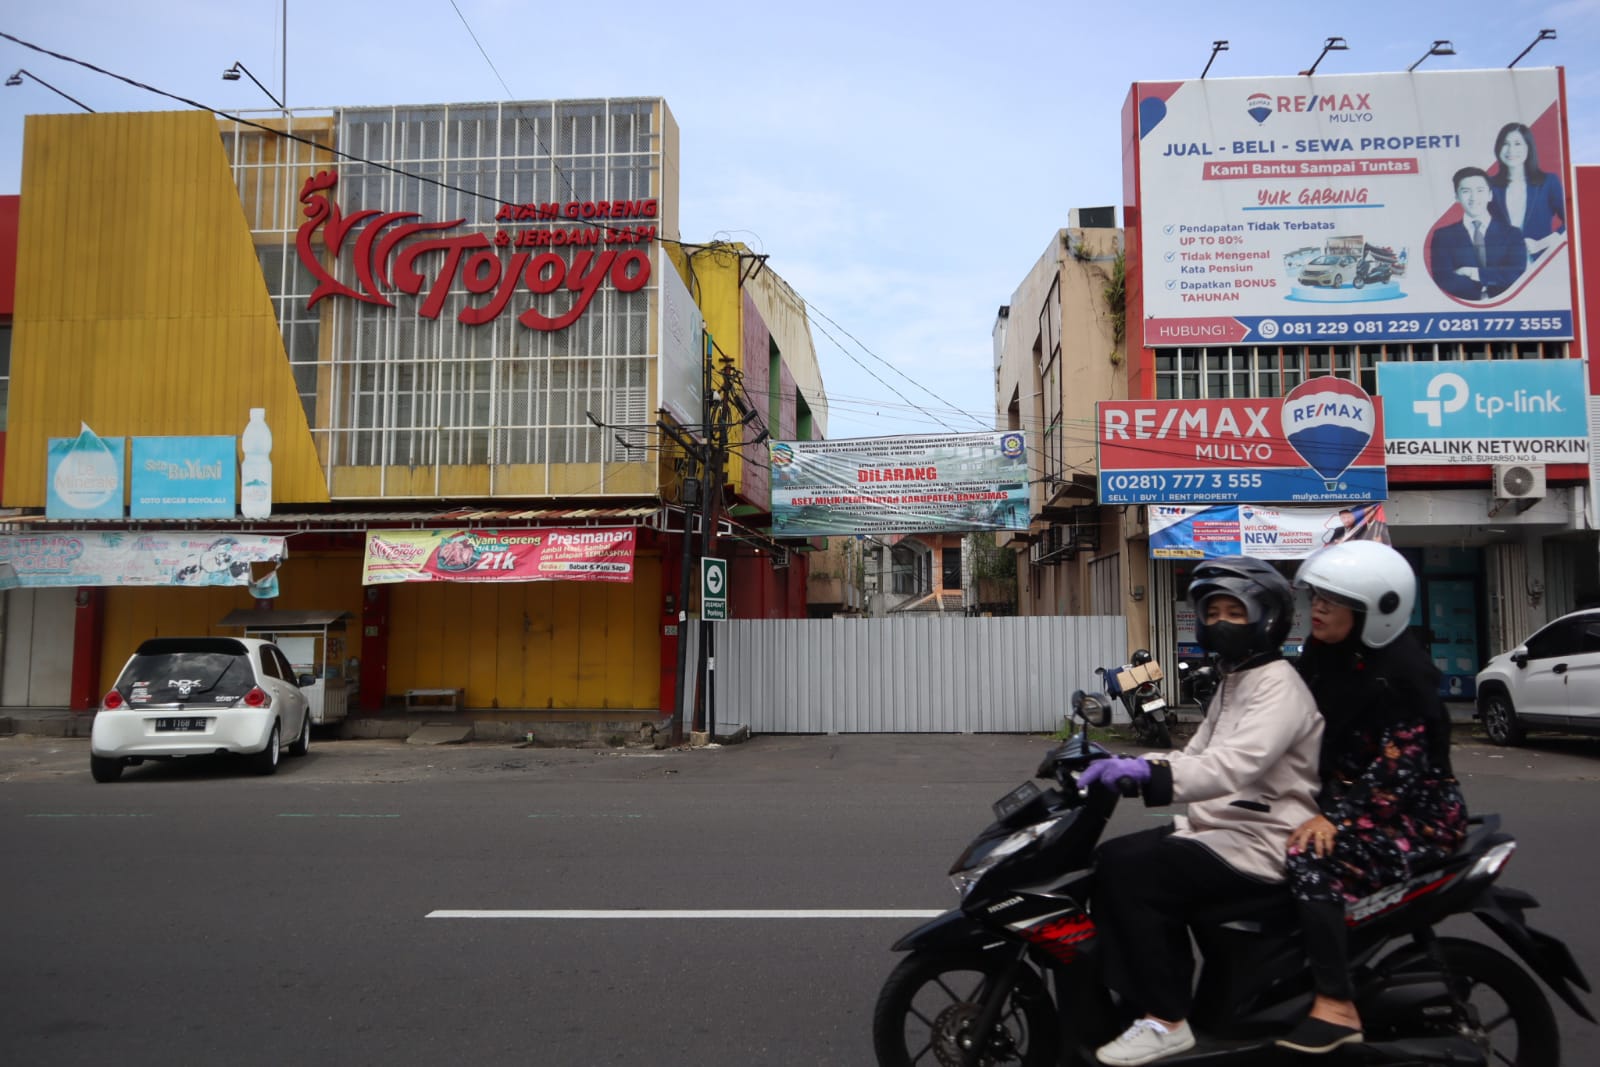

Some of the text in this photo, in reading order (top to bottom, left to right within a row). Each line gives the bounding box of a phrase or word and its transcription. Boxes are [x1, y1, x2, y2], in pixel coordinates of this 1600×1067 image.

[1277, 93, 1371, 112] RE/MAX
[1329, 112, 1373, 123] MULYO
[1163, 143, 1213, 156] JUAL
[1232, 140, 1275, 154] BELI
[1295, 138, 1354, 153] SEWA
[1361, 135, 1460, 150] PROPERTI
[1211, 160, 1411, 176] Kami Bantu Sampai Tuntas
[1298, 187, 1369, 205] GABUNG
[496, 200, 657, 221] AYAM GORENG
[1180, 221, 1335, 233] Pendapatan Tidak Terbatas
[494, 225, 657, 248] & JEROAN SAPI
[1180, 236, 1243, 246] UP TO 80%
[1180, 250, 1270, 261] Tidak Mengenal
[1180, 264, 1253, 274] Kata Pensiun
[393, 231, 652, 331] Tojoyo
[1180, 279, 1277, 291] Dapatkan BONUS
[1181, 293, 1240, 302] TAHUNAN
[1160, 325, 1226, 337] HUBUNGI
[1283, 317, 1562, 334] 081 229 081 229 / 0281 777 3555
[1475, 389, 1562, 419] tp-link
[1293, 403, 1363, 422] RE/MAX
[1104, 407, 1271, 440] RE/MAX
[1195, 444, 1273, 460] MULYO
[1385, 440, 1588, 454] MEGALINK NETWORKIN
[858, 466, 938, 483] DILARANG
[1107, 473, 1263, 491] (0281) 777 3 555
[791, 497, 813, 506] ASET
[815, 495, 841, 505] MILIK
[902, 493, 954, 504] KABUPATEN
[956, 491, 1009, 502] BANYUMAS
[1193, 493, 1239, 501] PROPERTY
[1292, 492, 1371, 501] mulyo.remax.co.id
[1159, 507, 1186, 515] TIKI
[468, 536, 542, 548] Ayam Goreng
[548, 531, 634, 546] Prasmanan
[1244, 533, 1278, 544] NEW
[477, 552, 517, 570] 21k
[569, 563, 588, 571] Babat
[611, 564, 627, 572] Sapi
